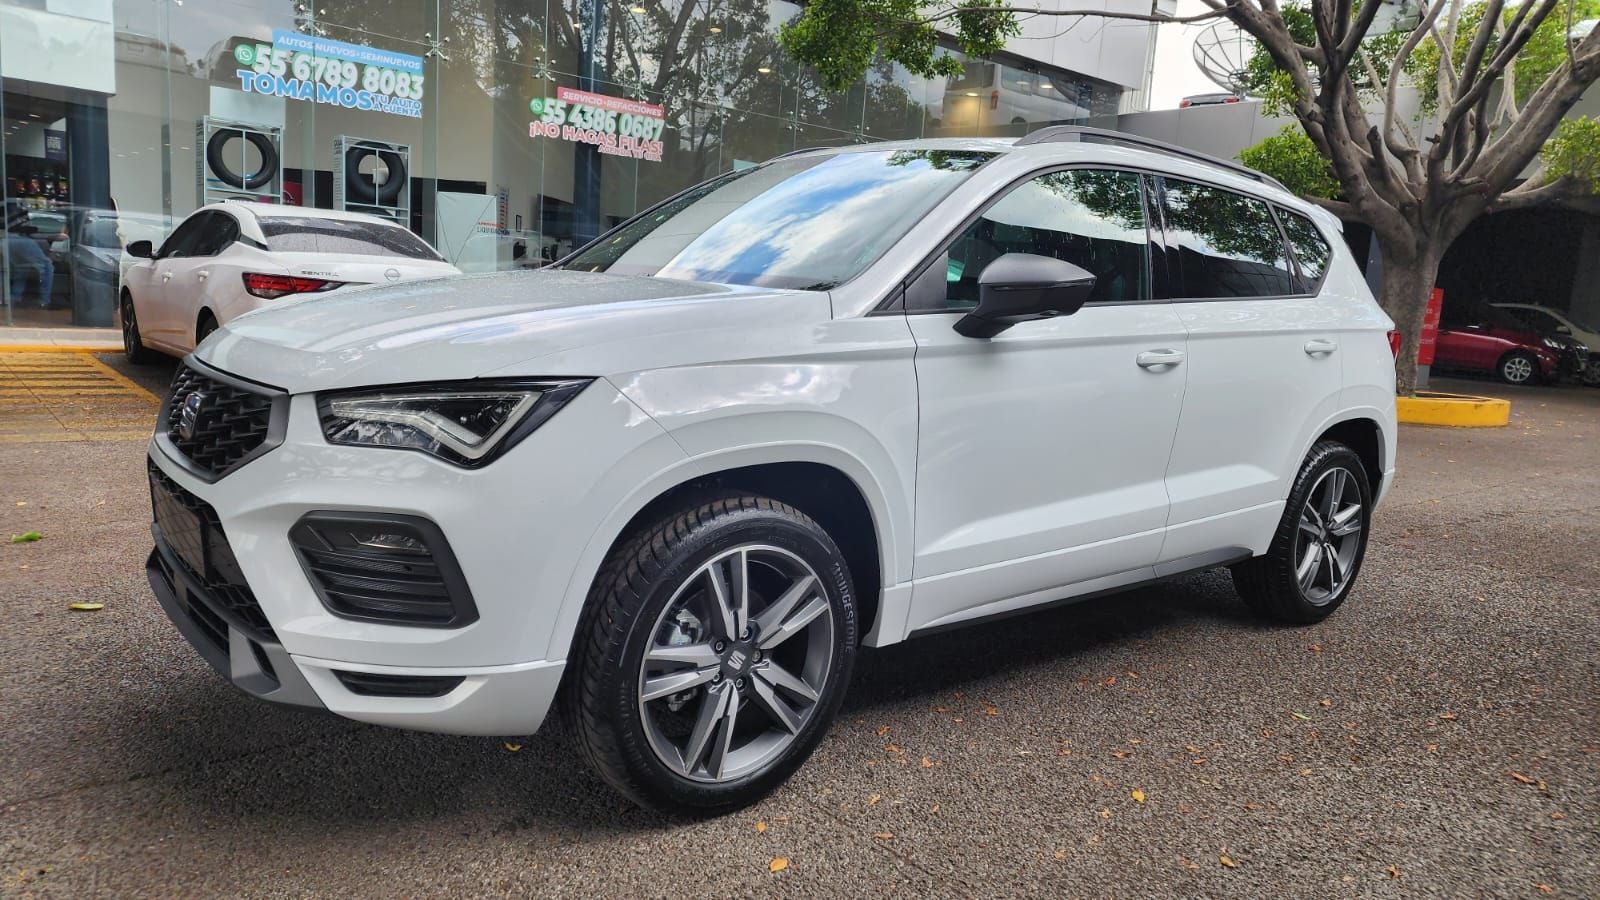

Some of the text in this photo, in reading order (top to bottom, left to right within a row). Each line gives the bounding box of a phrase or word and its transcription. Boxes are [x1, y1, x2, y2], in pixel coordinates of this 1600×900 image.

[278, 35, 421, 70] AUTOS NUEVOS SEMINUEVOS
[254, 43, 425, 100] 55 6789 8083
[237, 69, 373, 111] TOMAMOS
[373, 93, 422, 110] TU AUTO
[563, 91, 662, 117] SERVICIO REFACCIONES
[383, 104, 422, 119] CUENTA
[542, 97, 665, 142] 55 4386 0687
[562, 125, 617, 147] HAGAS
[619, 134, 664, 155] FILAS!
[831, 561, 855, 656] BRIDGESTONE
